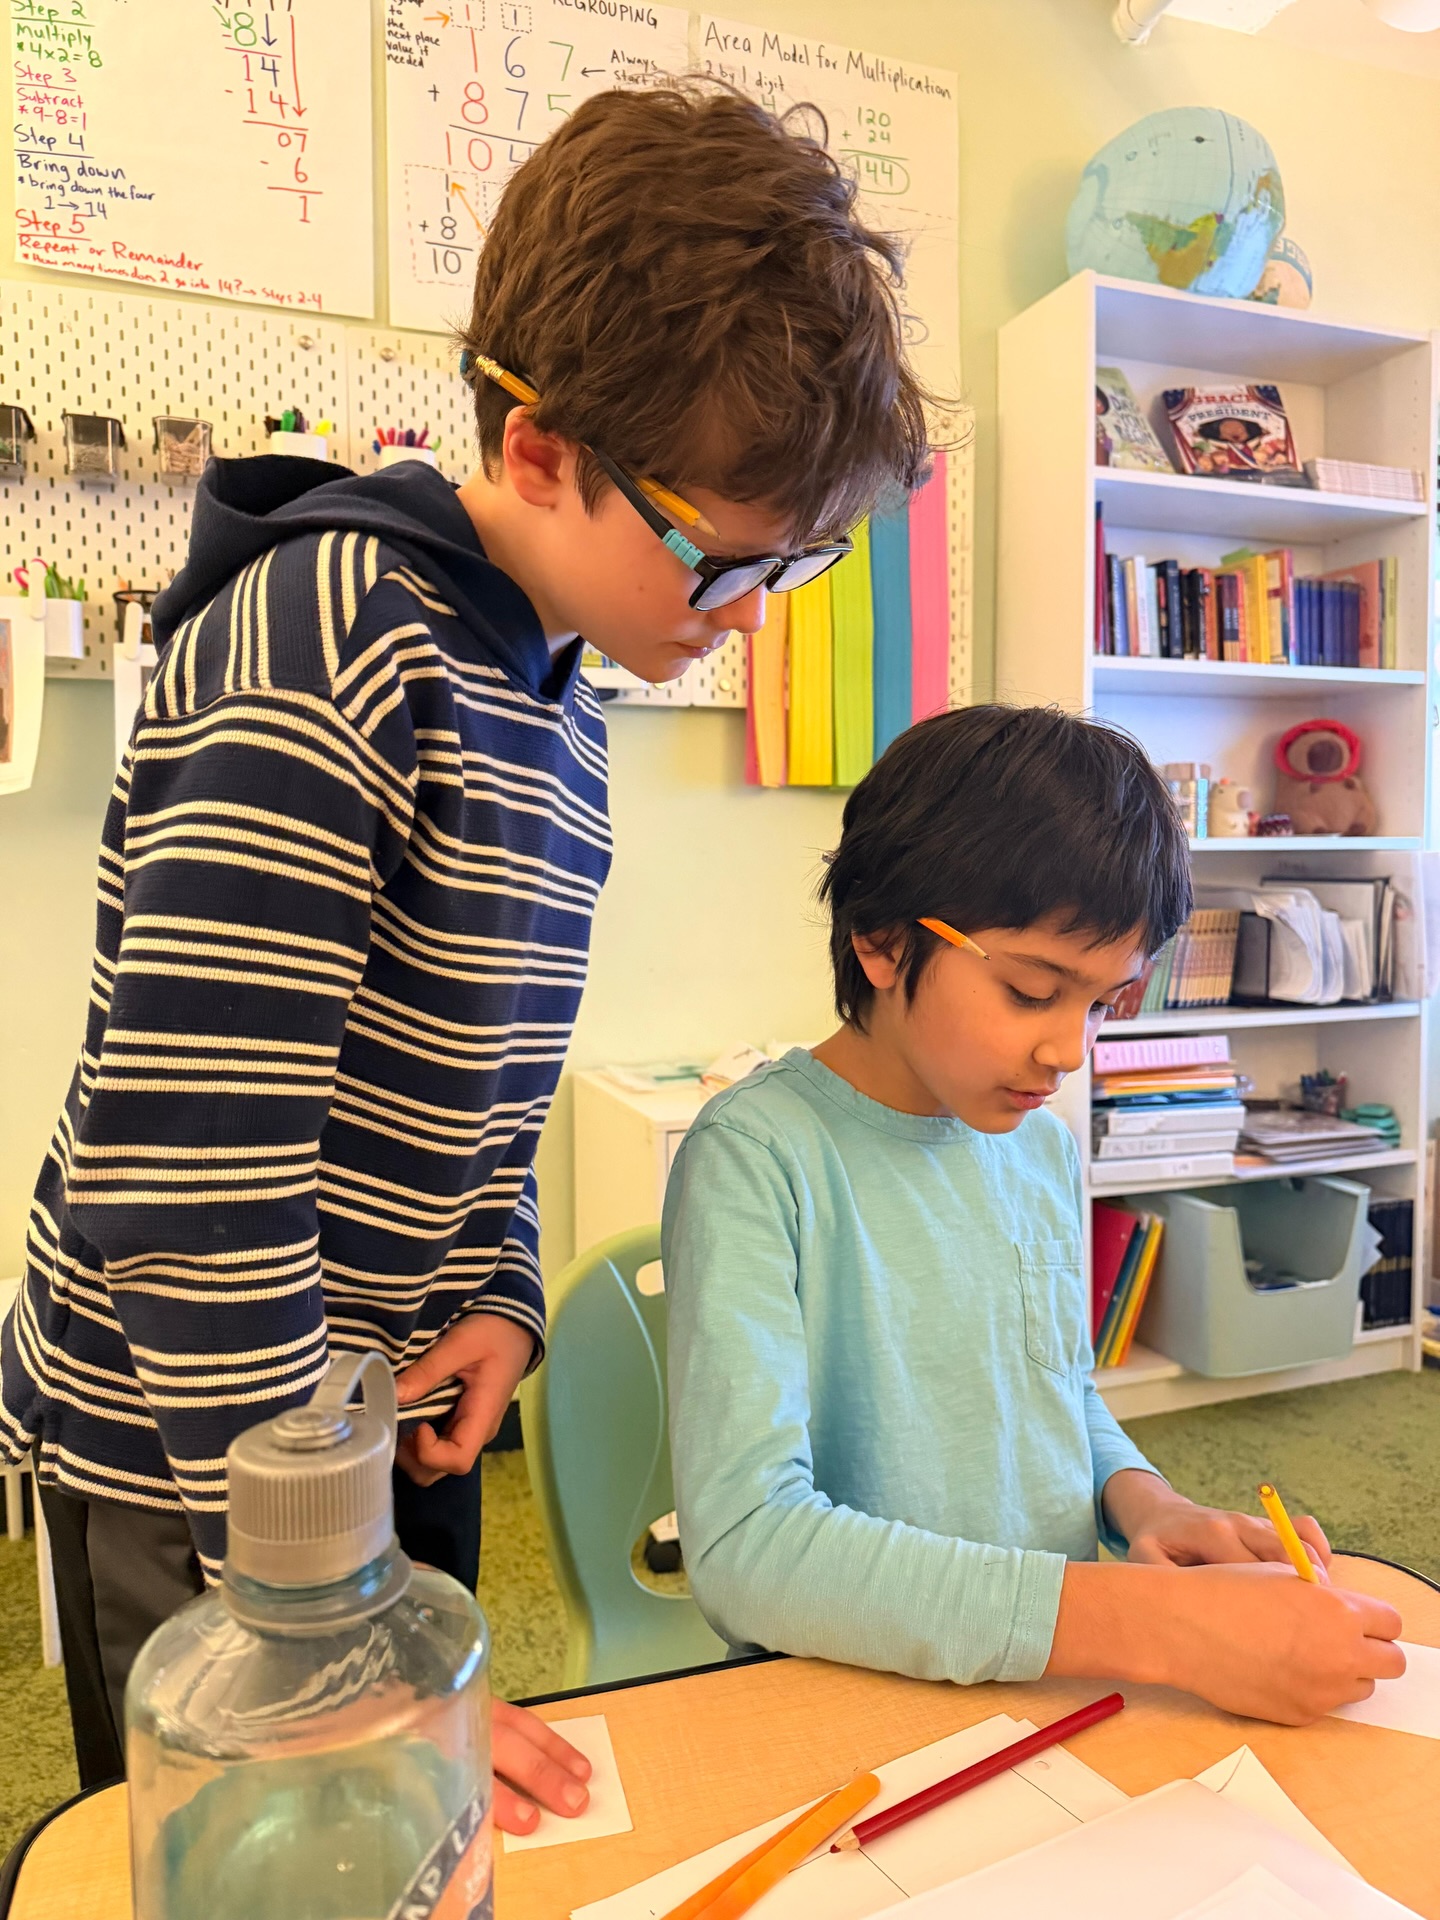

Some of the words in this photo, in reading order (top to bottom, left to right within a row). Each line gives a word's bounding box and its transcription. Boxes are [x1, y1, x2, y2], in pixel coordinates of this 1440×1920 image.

[10, 0, 60, 25] Step
[71, 0, 87, 19] 2
[389, 5, 403, 16] to
[552, 0, 658, 29] GROUPING
[17, 22, 92, 51] Multiply
[387, 18, 405, 30] the
[387, 30, 412, 41] next
[415, 31, 441, 47] place
[419, 45, 429, 56] if
[387, 54, 425, 69] needed
[610, 49, 658, 73] Always
[705, 21, 752, 54] Area
[761, 31, 810, 66] Model
[816, 44, 838, 70] for
[846, 50, 952, 100] Multiplication
[14, 60, 53, 88] Step
[62, 67, 77, 83] 3
[705, 60, 714, 75] 2
[719, 63, 735, 85] by
[755, 71, 785, 95] digit
[16, 87, 84, 109] Subtract
[857, 106, 892, 127] 120
[14, 124, 57, 151] Step
[68, 132, 85, 152] 4
[278, 132, 307, 153] 07
[868, 129, 892, 145] 24
[17, 154, 71, 183] Bring
[77, 160, 126, 180] down
[294, 157, 308, 183] 6
[856, 155, 894, 187] 144
[28, 174, 66, 197] bring
[70, 180, 103, 196] down
[108, 186, 128, 199] the
[130, 185, 156, 200] four
[84, 201, 108, 220] 14
[298, 195, 311, 223] 1
[15, 208, 61, 236] Step
[69, 213, 90, 234] 5
[19, 234, 79, 255] Repeat
[89, 247, 106, 256] or
[112, 241, 203, 270] Remainder
[160, 270, 170, 283] 2
